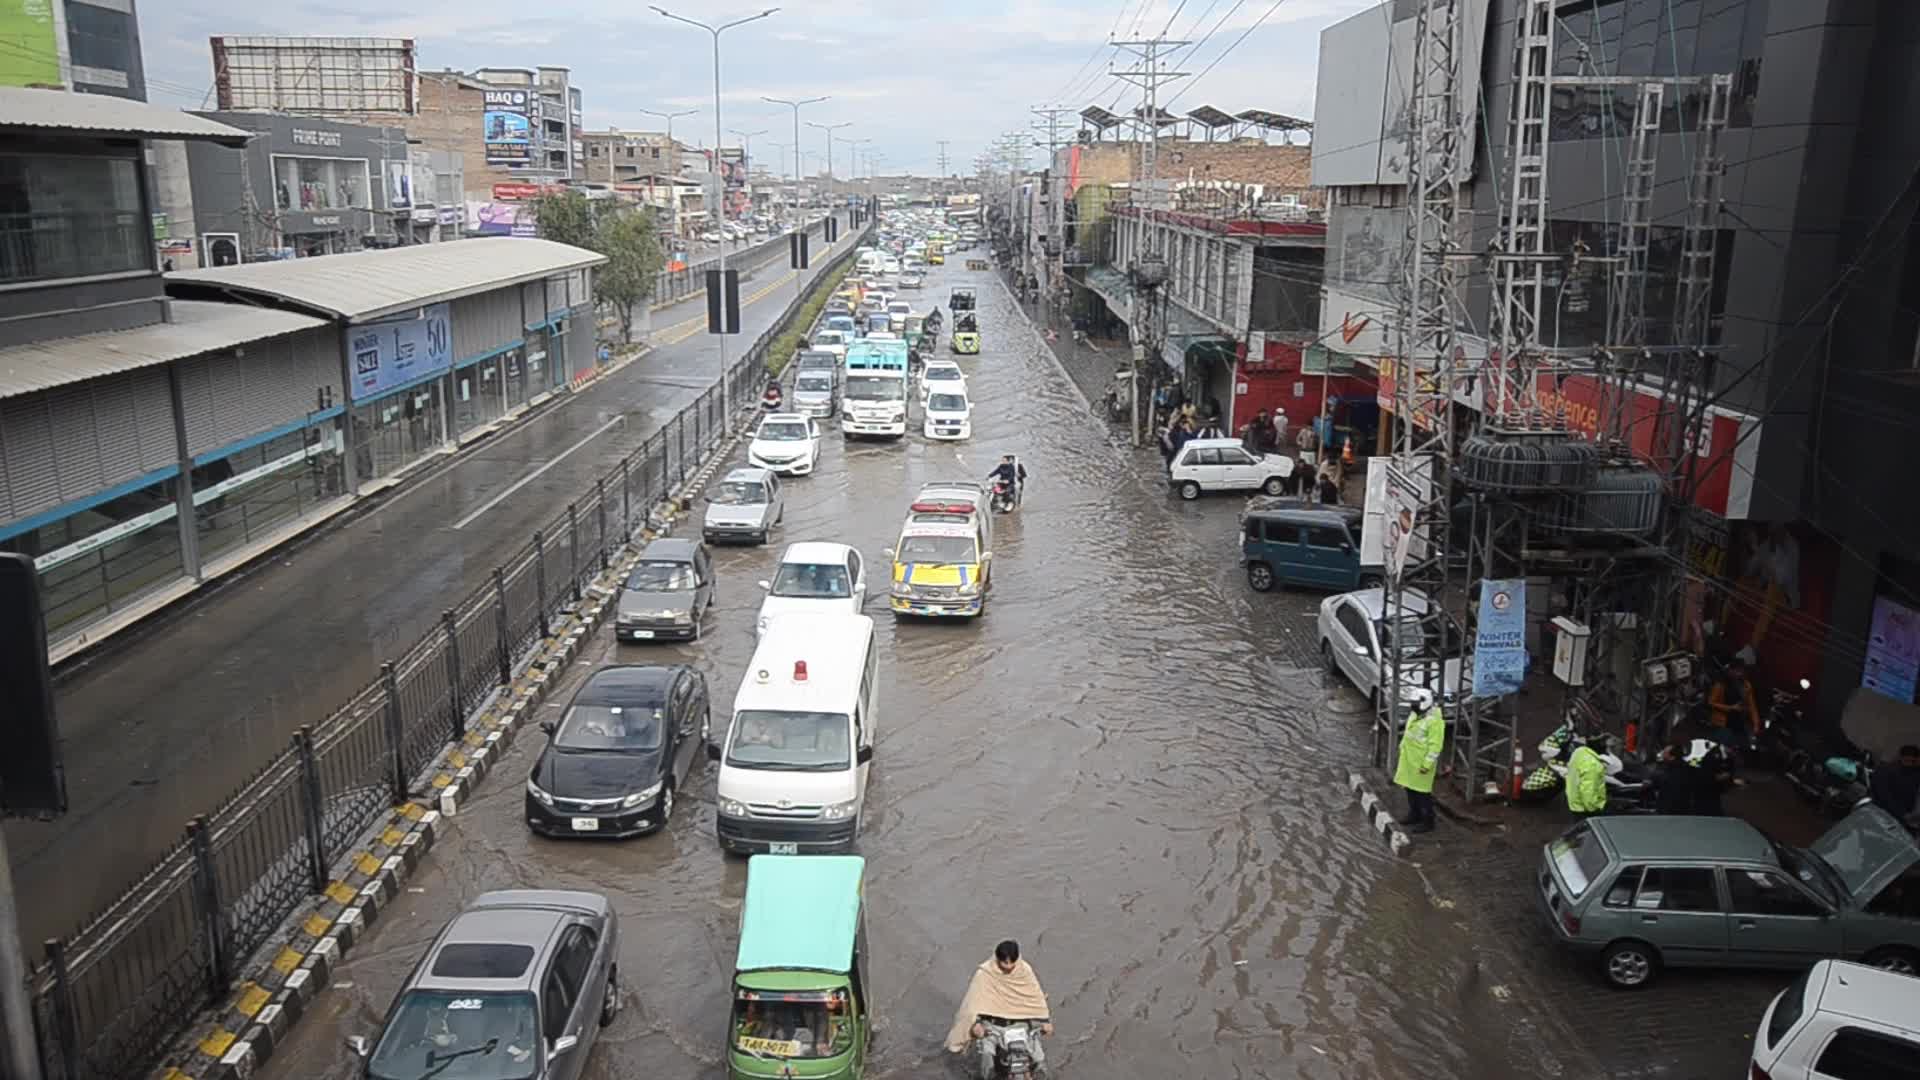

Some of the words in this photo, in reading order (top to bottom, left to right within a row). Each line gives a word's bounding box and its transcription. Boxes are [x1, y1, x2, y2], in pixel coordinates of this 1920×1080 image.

[485, 91, 513, 105] HAQ
[426, 319, 447, 358] 50
[1524, 385, 1598, 432] perience
[1479, 631, 1522, 641] WINTER
[1478, 640, 1522, 649] ARRIVALS
